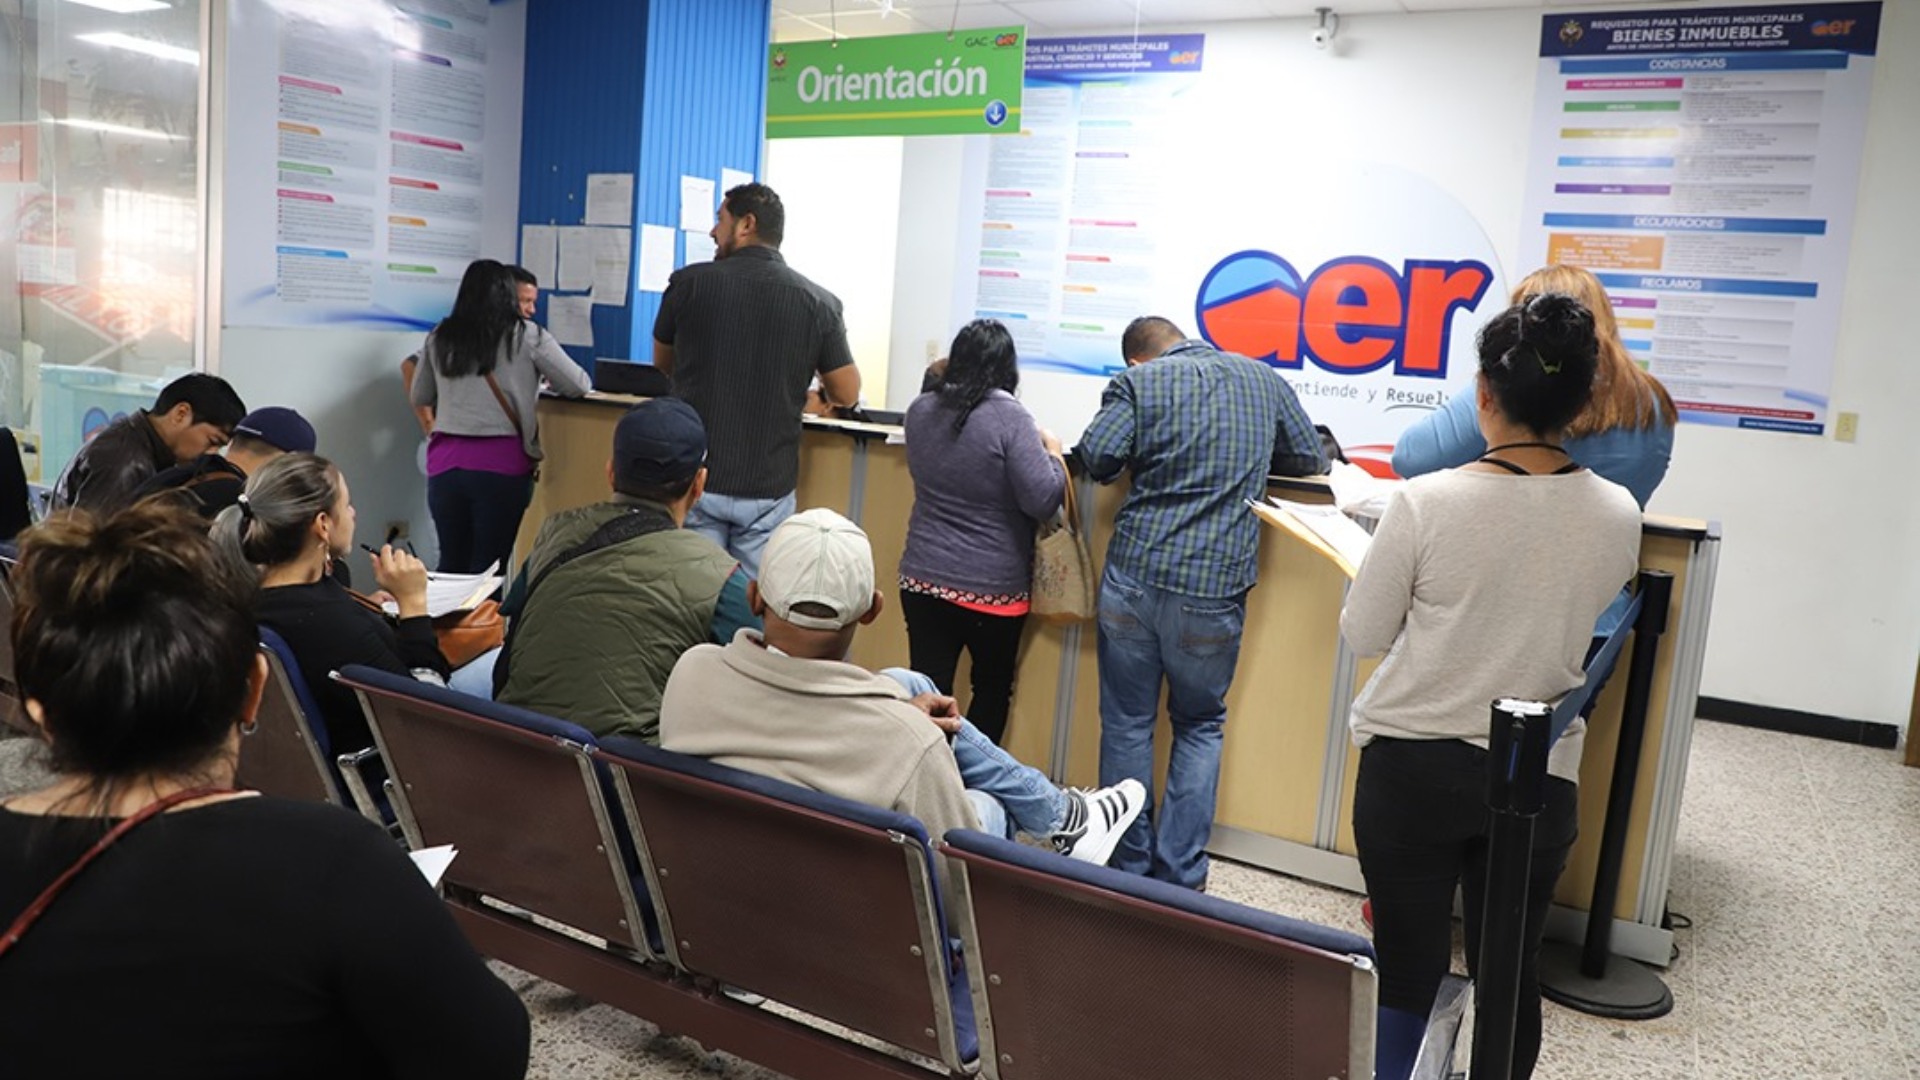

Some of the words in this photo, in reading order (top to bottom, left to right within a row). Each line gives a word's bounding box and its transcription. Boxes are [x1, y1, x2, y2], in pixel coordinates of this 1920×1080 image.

[1591, 19, 1650, 30] REQUISITOS
[1651, 18, 1678, 27] PARA
[1680, 15, 1729, 26] TRÁMITES
[1733, 13, 1803, 24] MUNICIPALES
[1612, 27, 1675, 43] BIENES
[1679, 25, 1784, 41] INMUEBLES
[1649, 58, 1727, 70] CONSTANCIAS
[797, 56, 987, 103] Orientación
[1633, 215, 1725, 229] DECLARACIONES
[1641, 277, 1701, 290] RECLAMOS
[1367, 389, 1378, 404] y
[1386, 387, 1449, 406] Resuel
